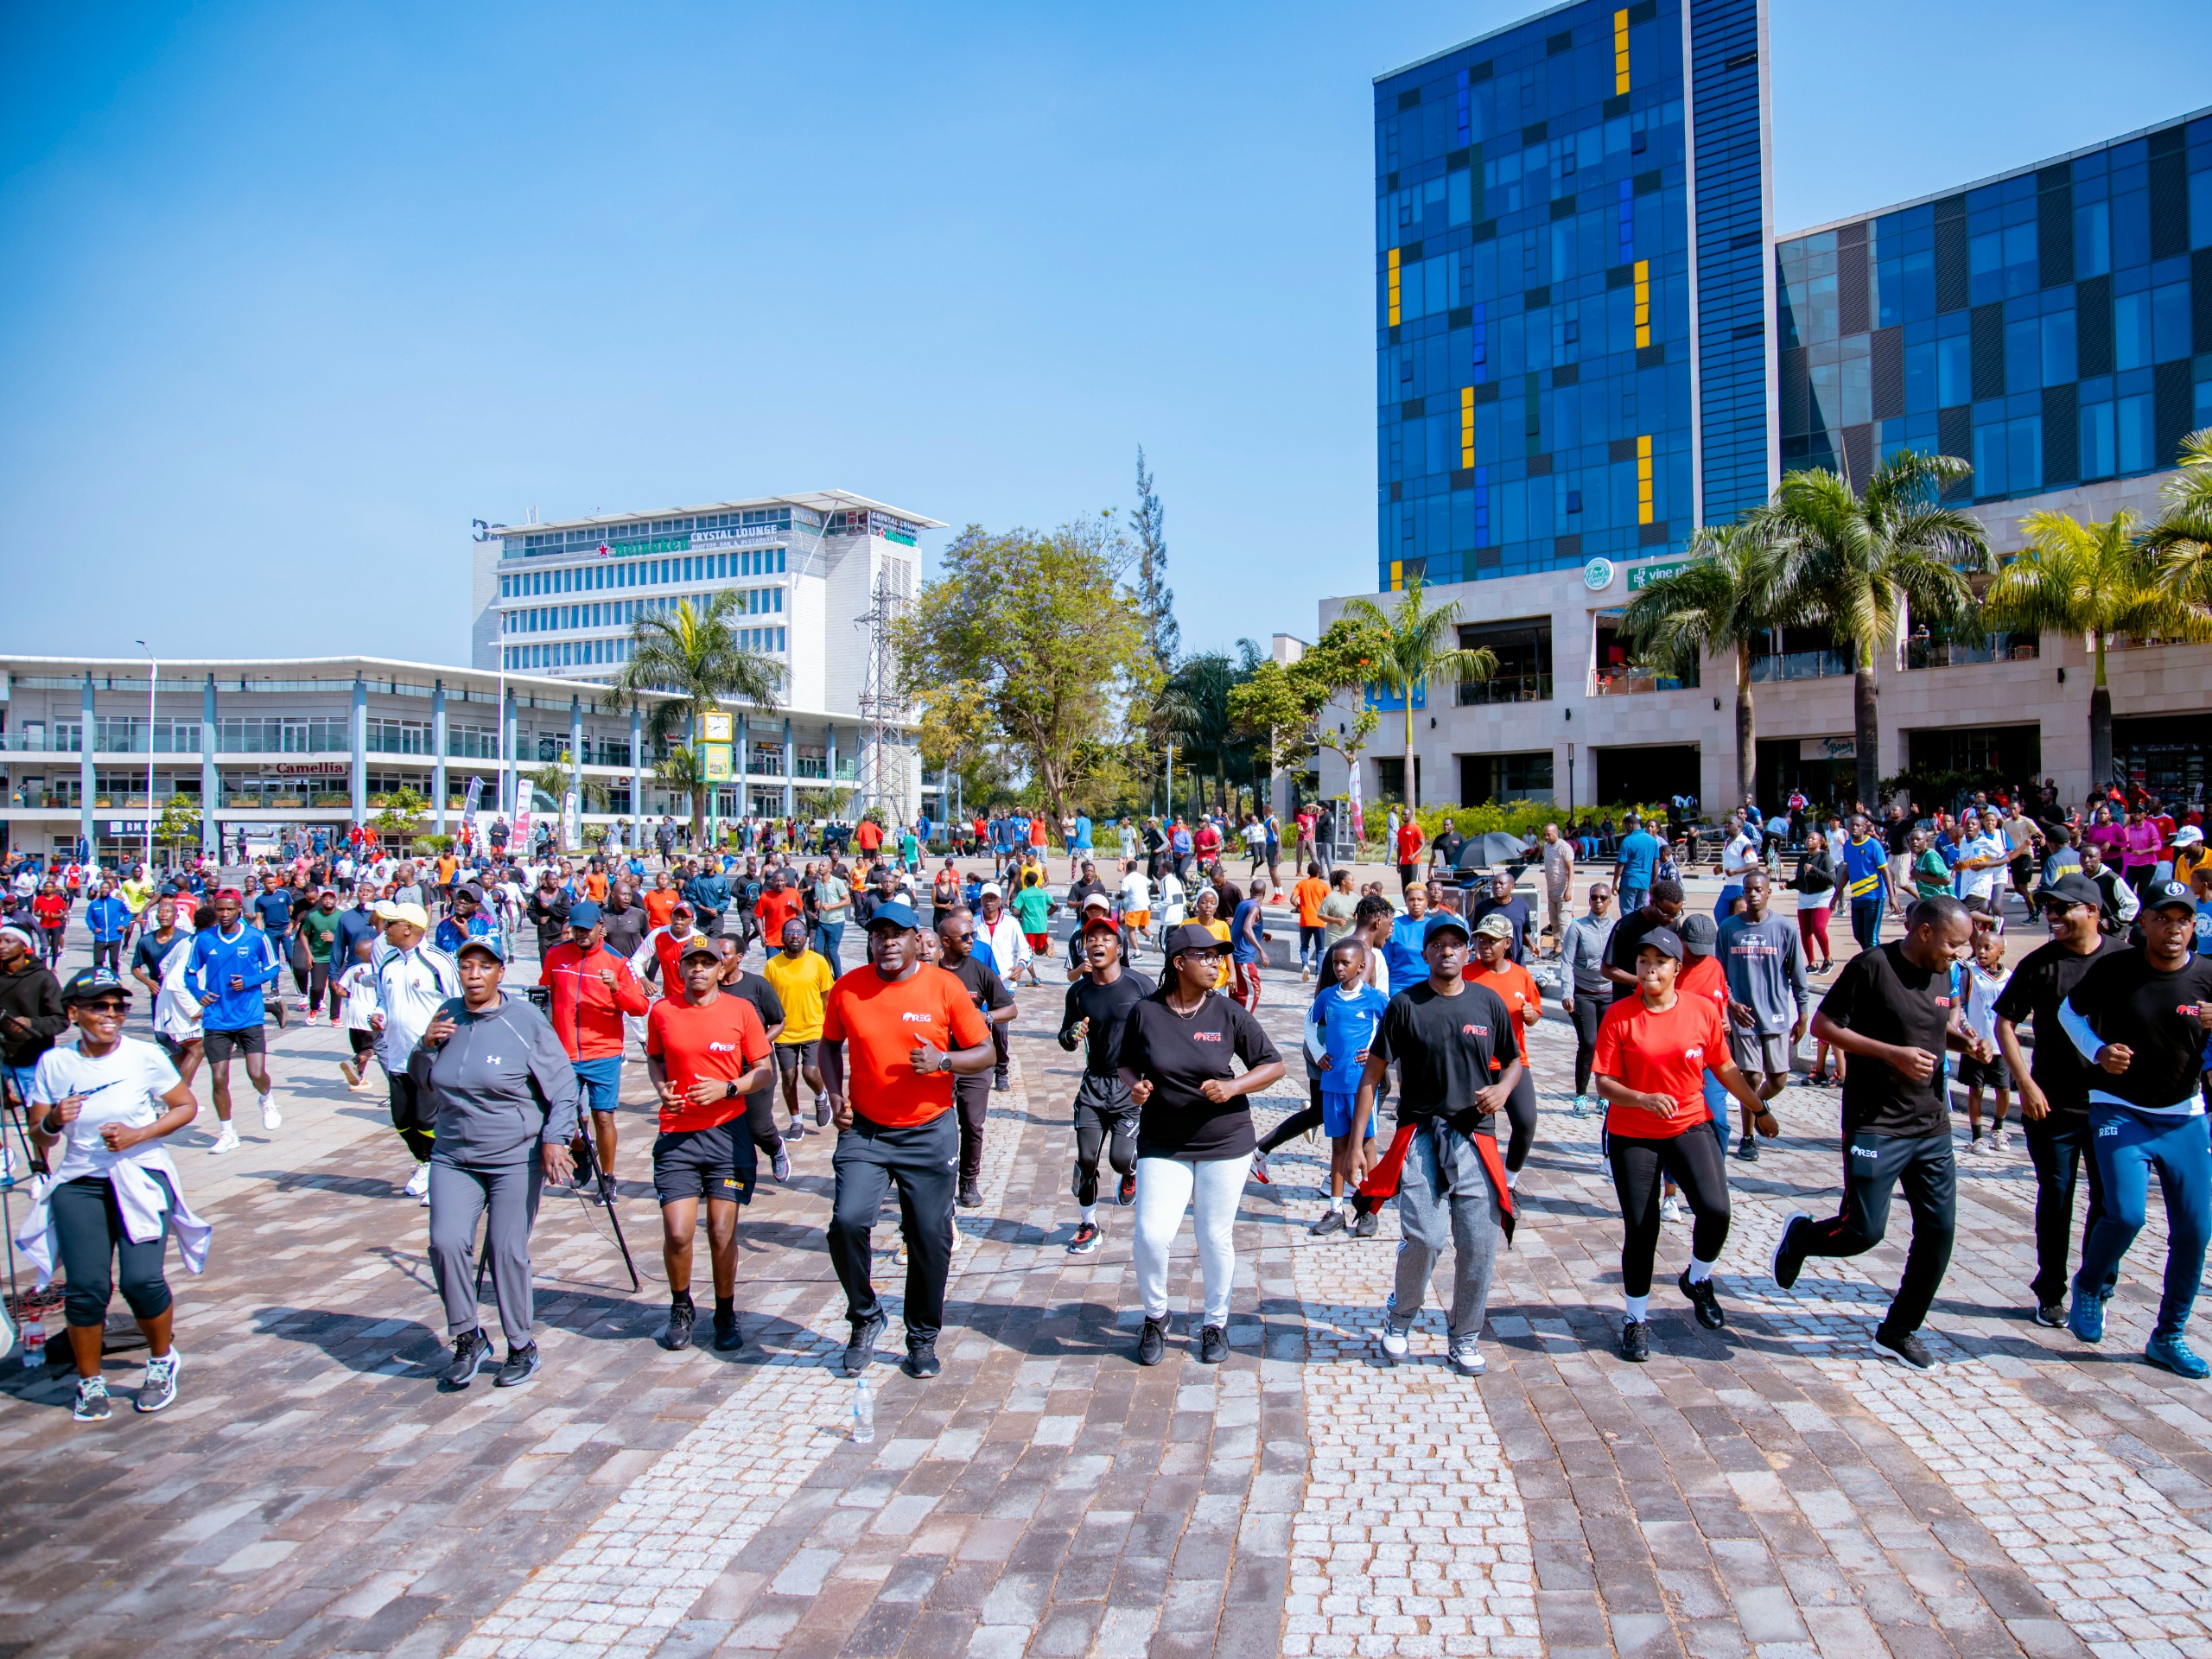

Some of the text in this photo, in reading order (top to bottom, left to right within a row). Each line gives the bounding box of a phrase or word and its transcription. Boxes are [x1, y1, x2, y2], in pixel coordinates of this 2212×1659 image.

[690, 524, 777, 543] CRYSTAL LOUNGE
[614, 537, 690, 557] Heineken
[1649, 569, 1673, 581] vine
[276, 762, 344, 774] Camellia
[126, 822, 142, 832] BM
[1731, 946, 1778, 955] DETROIT TIGERS
[2187, 1007, 2200, 1016] RE
[2099, 1127, 2118, 1137] REG
[1857, 1148, 1878, 1159] REG
